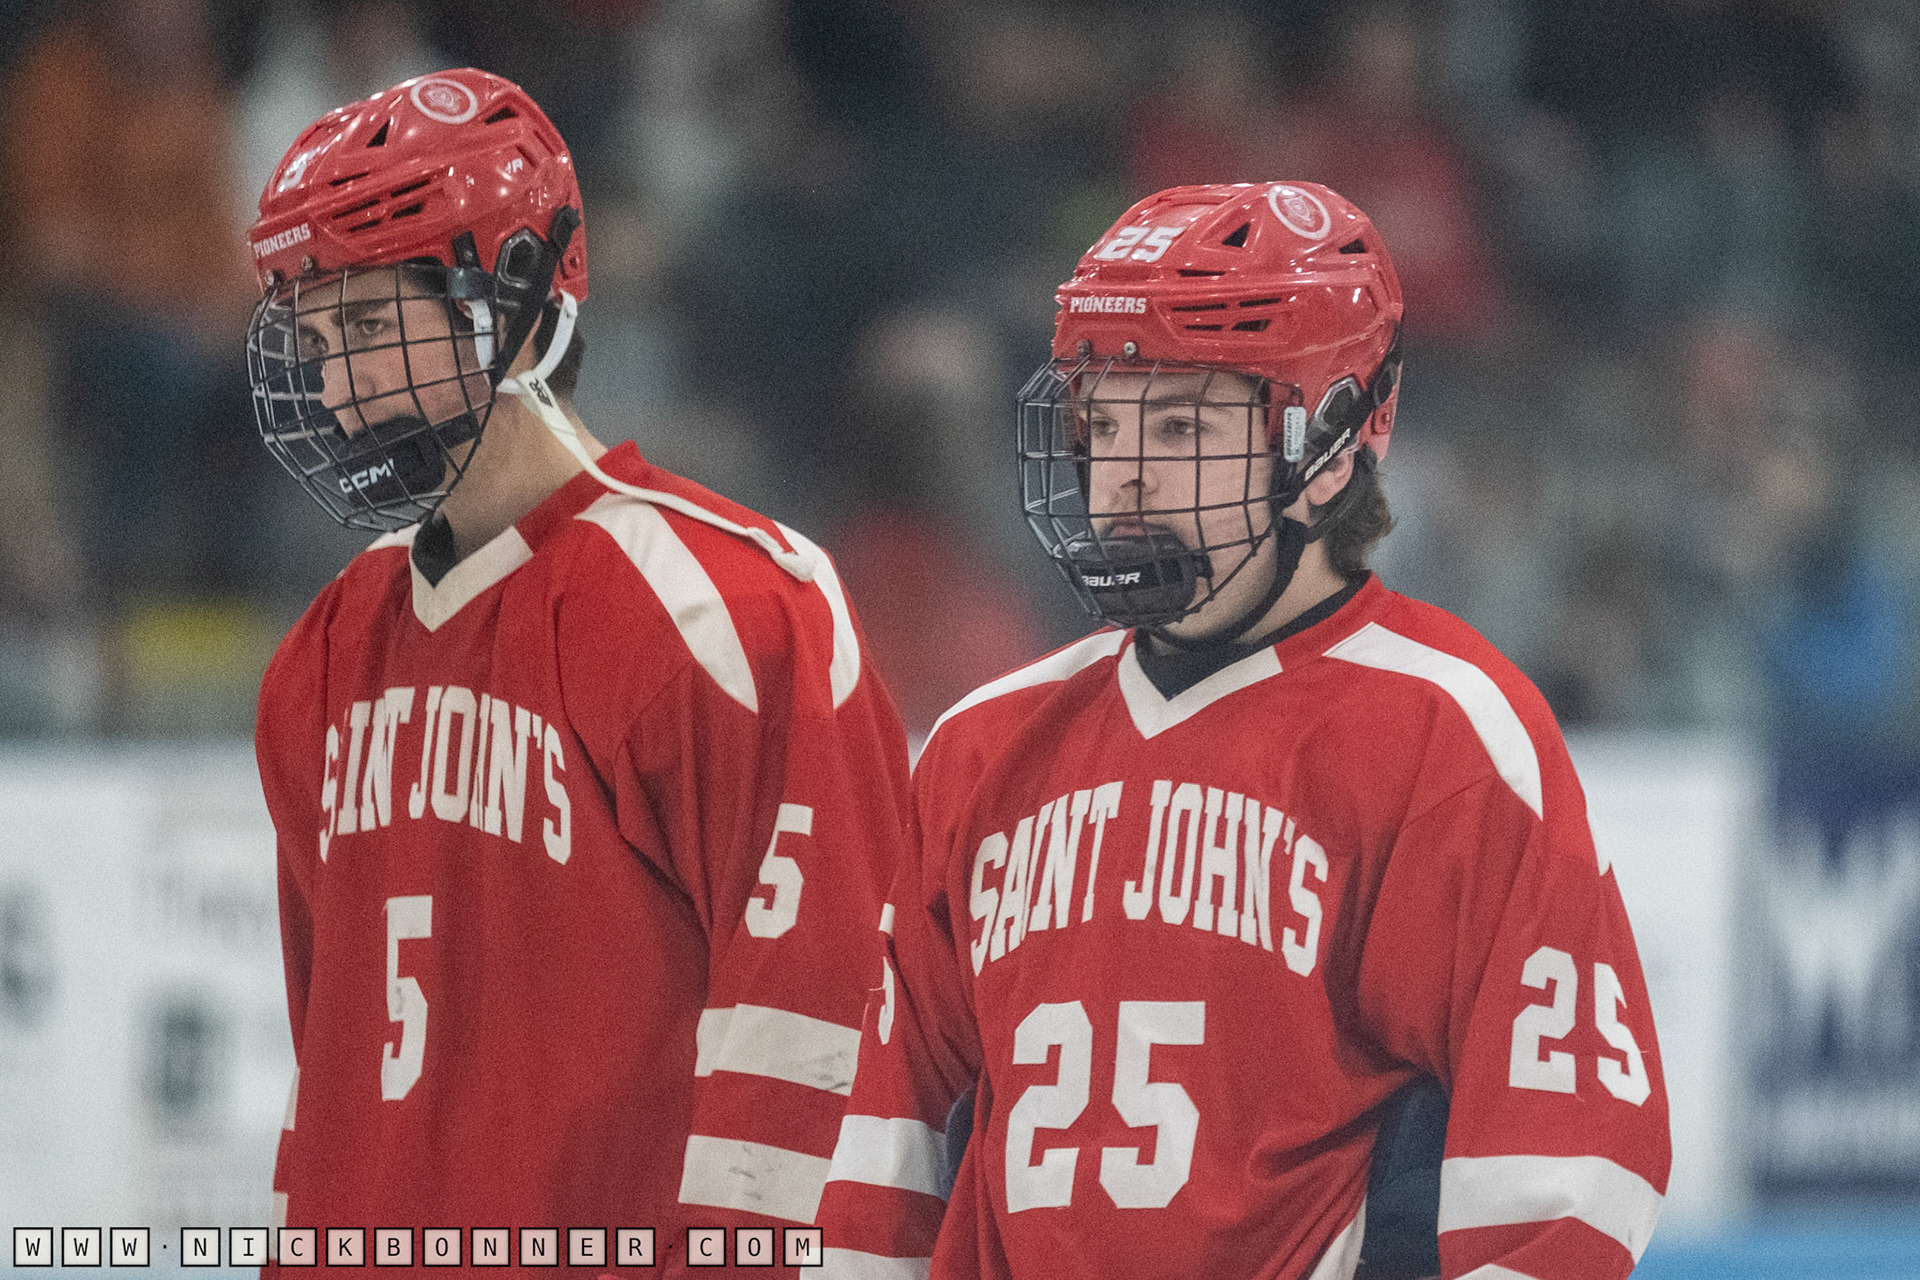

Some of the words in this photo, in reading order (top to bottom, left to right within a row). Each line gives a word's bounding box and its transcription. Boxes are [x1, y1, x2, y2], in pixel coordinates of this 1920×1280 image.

[253, 222, 312, 259] PIONEERS
[1070, 296, 1147, 314] PIONEERS
[1093, 226, 1186, 262] 25
[339, 458, 395, 494] CCM
[1305, 428, 1351, 481] BAUER
[319, 686, 416, 864] SINT
[744, 802, 814, 939] 5
[969, 780, 1124, 977] SAINT
[1122, 779, 1329, 978] JOHN'S
[381, 895, 433, 1101] 5
[1508, 945, 1652, 1107] 25
[1005, 999, 1206, 1214] 25
